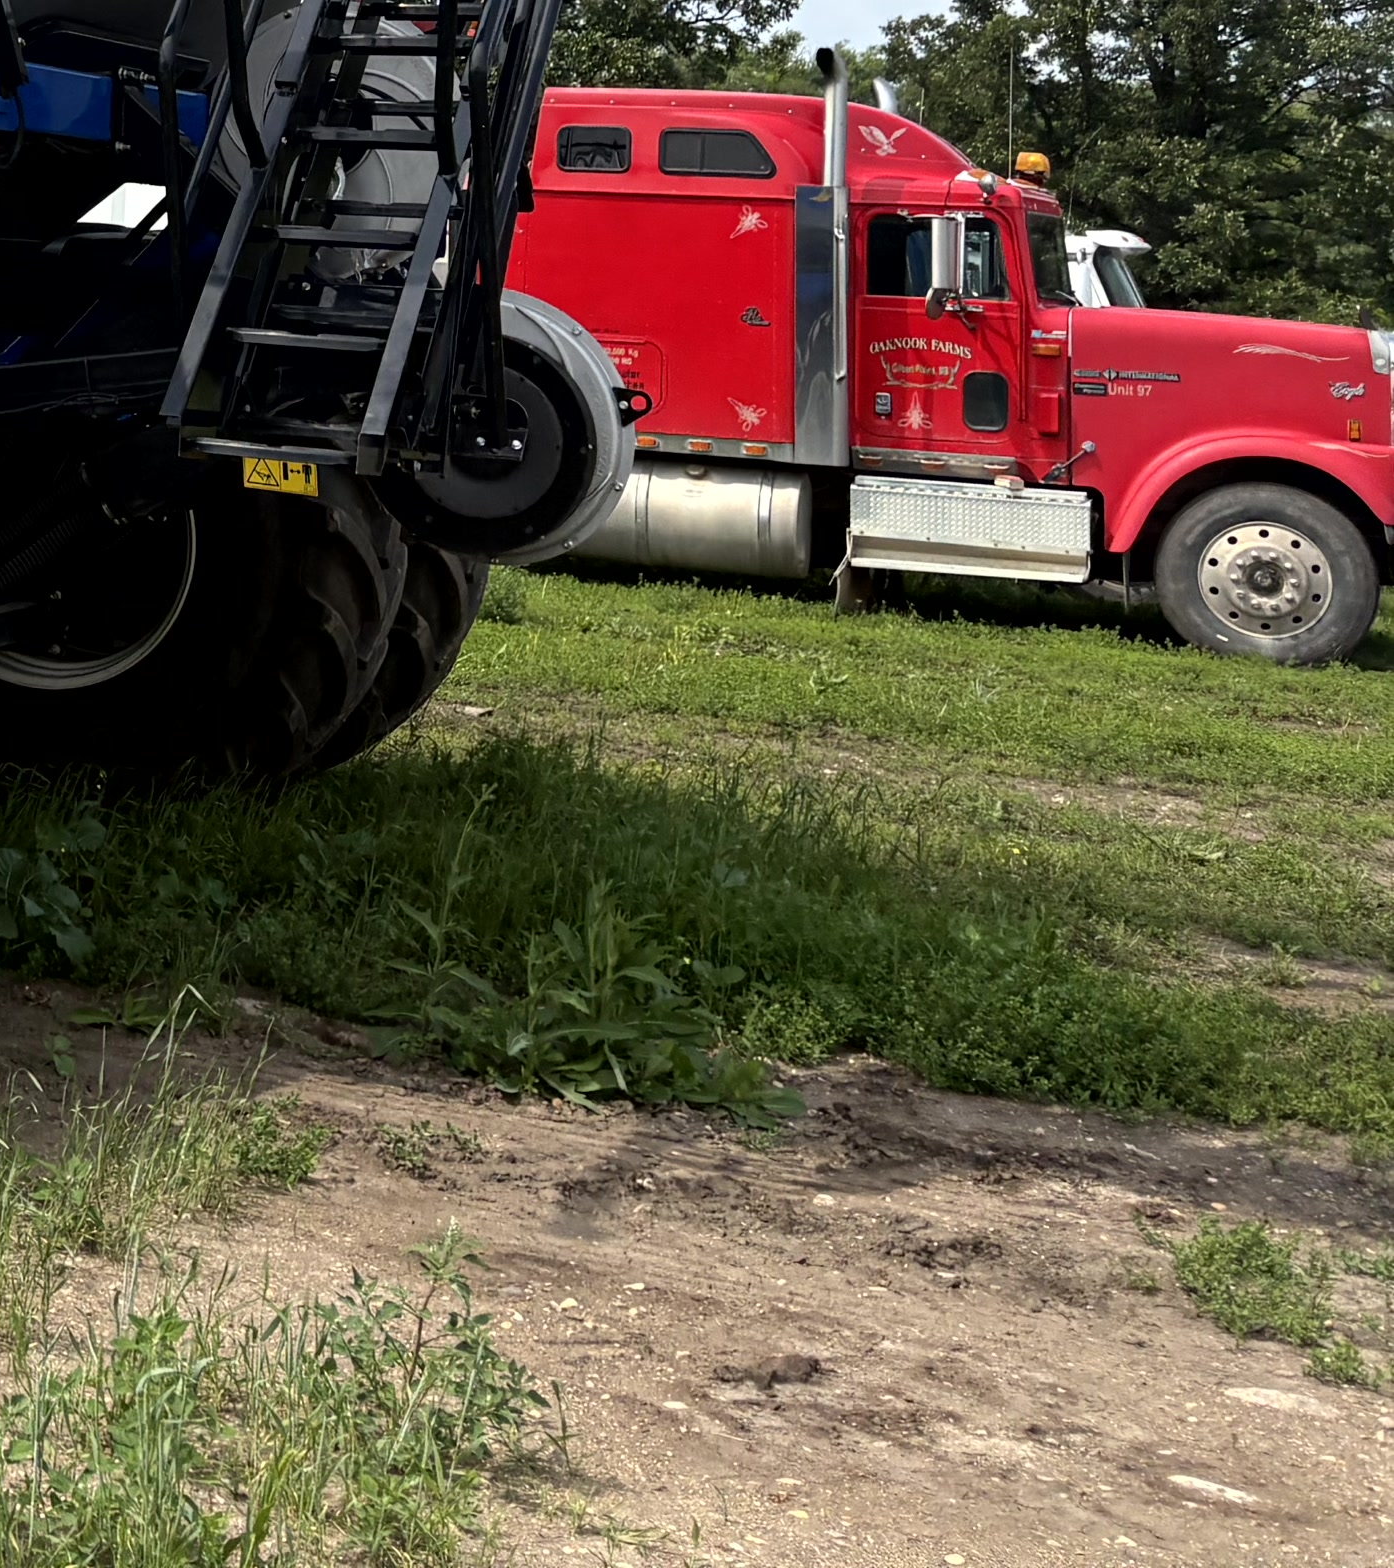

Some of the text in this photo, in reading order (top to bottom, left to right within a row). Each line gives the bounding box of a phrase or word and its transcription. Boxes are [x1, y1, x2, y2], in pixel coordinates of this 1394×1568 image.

[869, 336, 973, 360] OAKNOOK FARMS
[1107, 382, 1134, 396] Unit
[1136, 384, 1153, 397] 97
